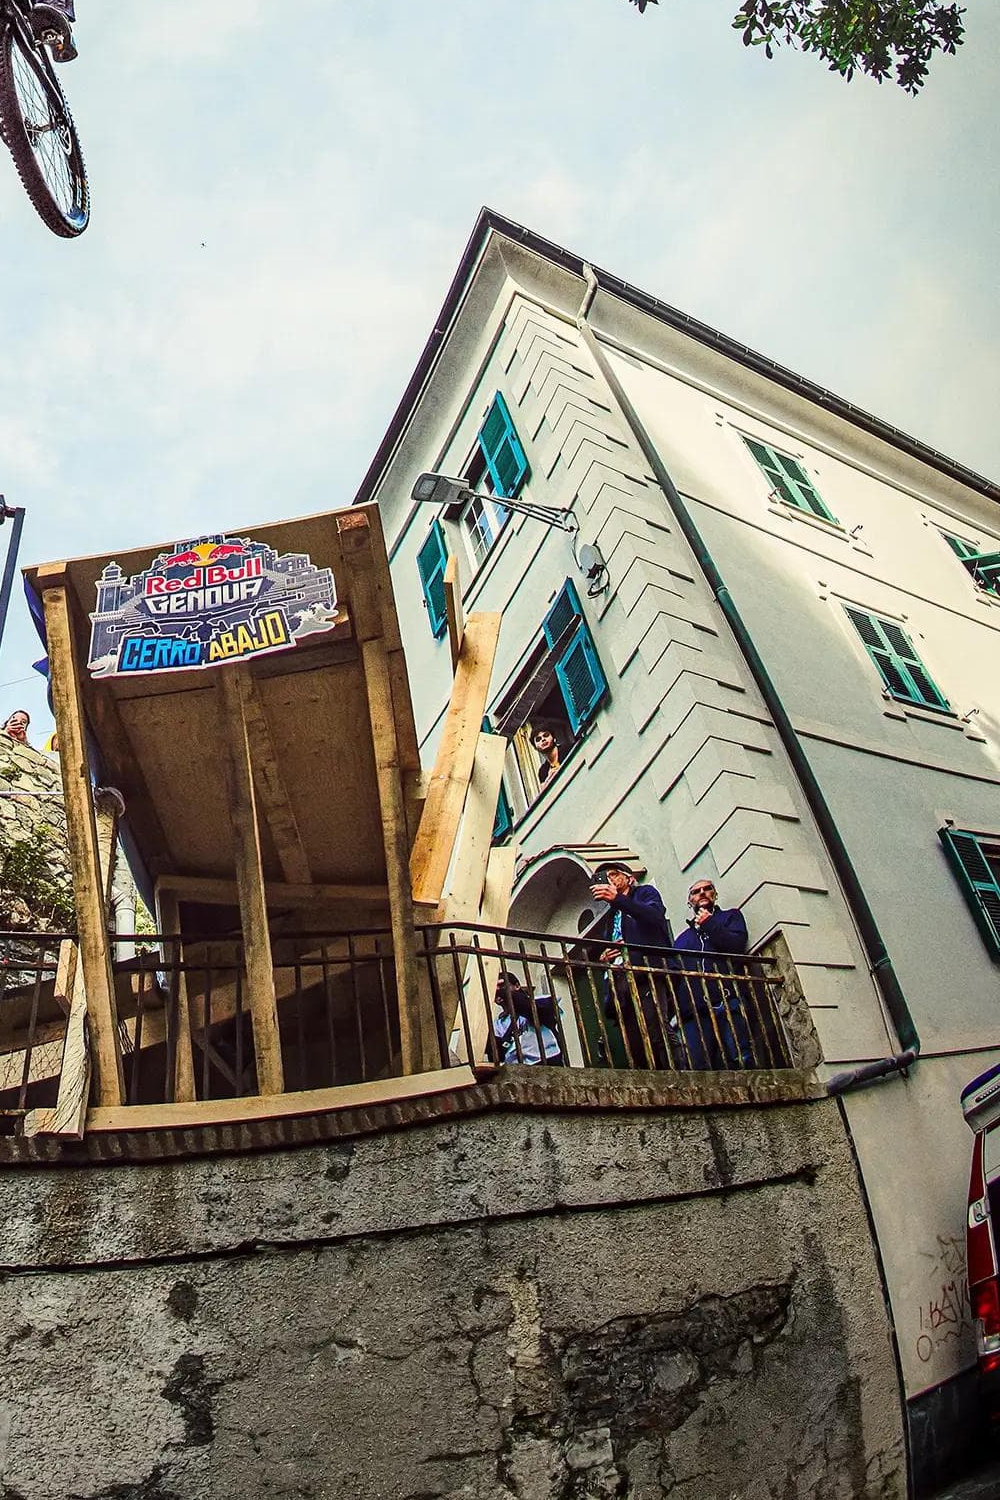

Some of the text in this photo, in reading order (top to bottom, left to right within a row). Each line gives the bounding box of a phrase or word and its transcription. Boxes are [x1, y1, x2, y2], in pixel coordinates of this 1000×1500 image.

[146, 557, 262, 595] Red Bull
[122, 611, 286, 670] CERRO ABAJO
